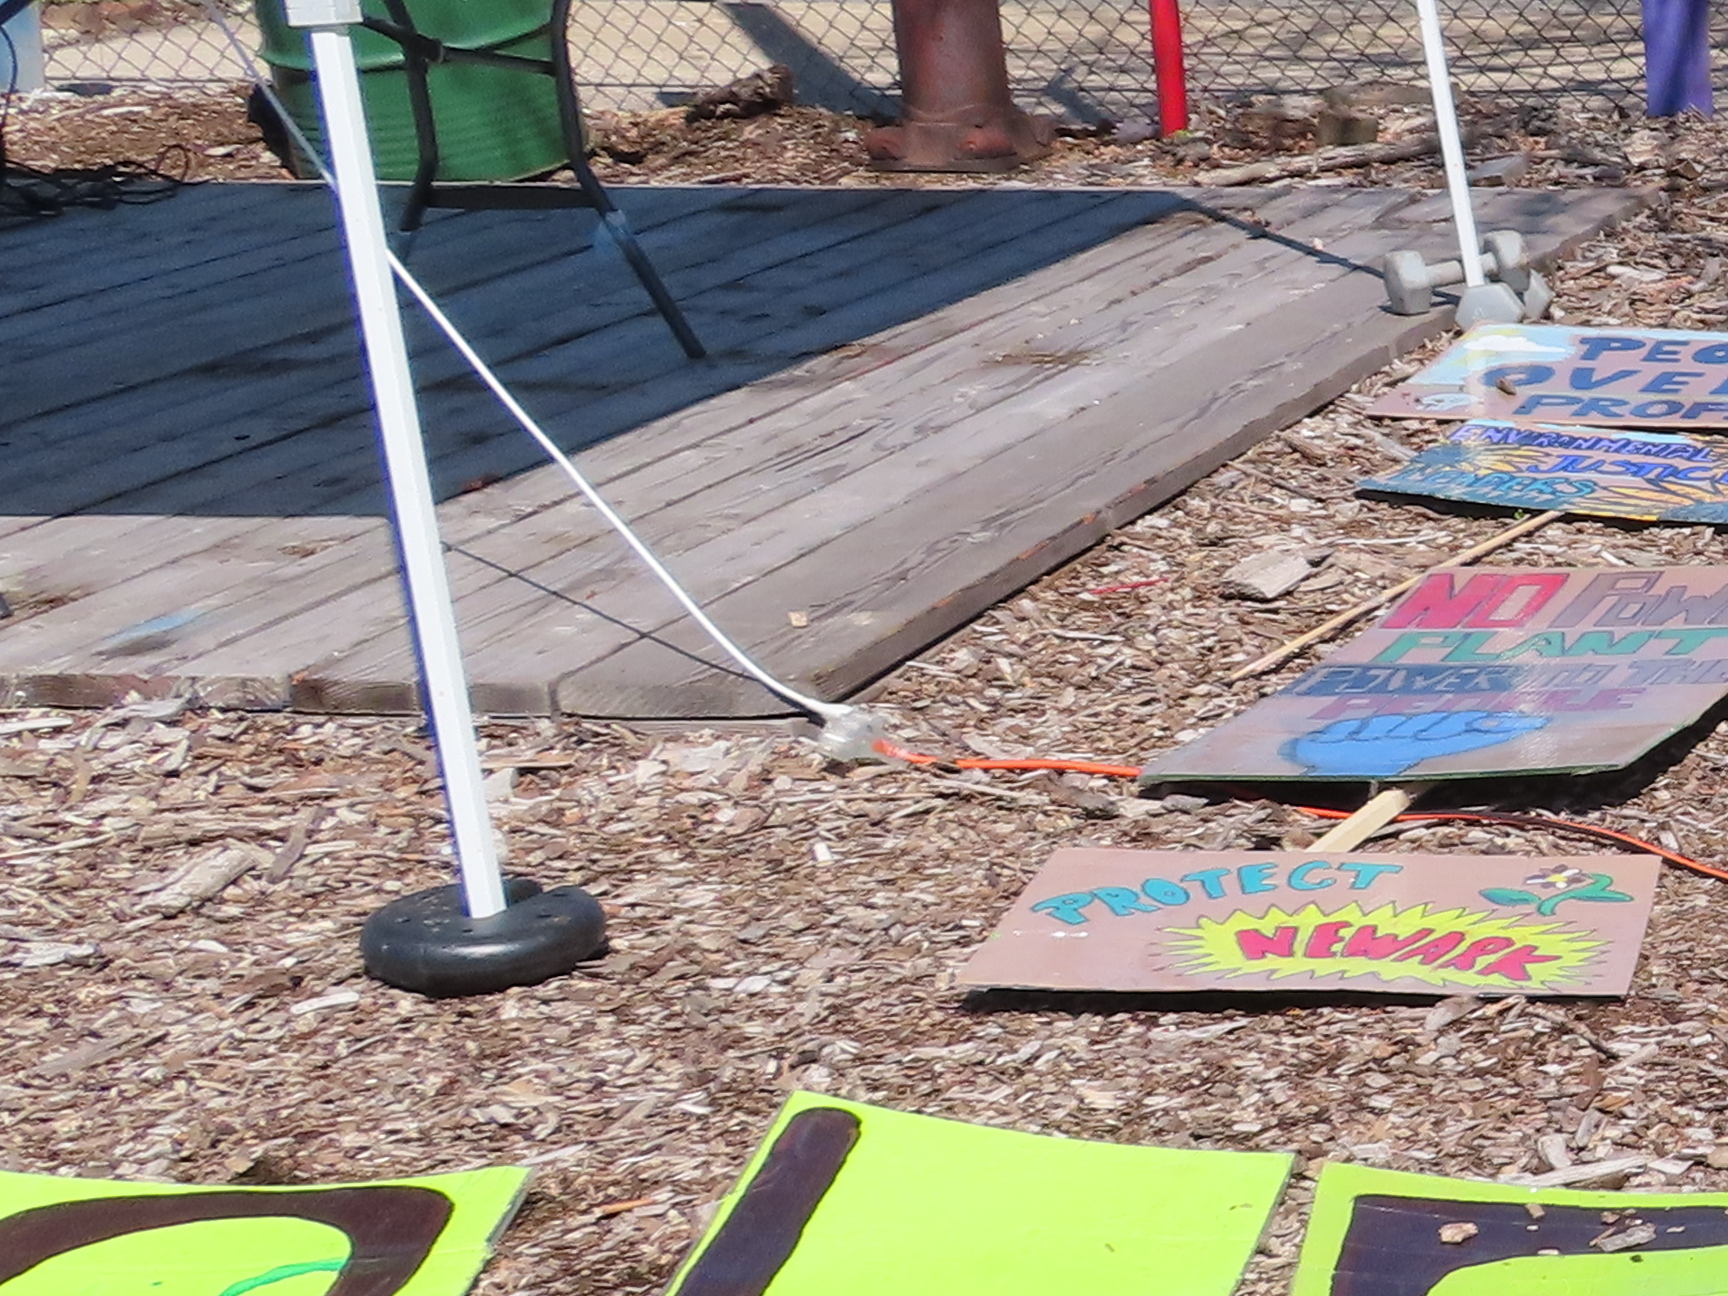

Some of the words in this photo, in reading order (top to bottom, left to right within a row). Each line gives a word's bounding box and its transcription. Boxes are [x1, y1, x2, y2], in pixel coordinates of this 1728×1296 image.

[1449, 424, 1717, 463] ENVIRONMENTAL
[1382, 572, 1569, 630] NO
[1291, 664, 1514, 696] POWER
[1030, 859, 1404, 926] PROTECT
[1235, 921, 1562, 983] NEWARK
